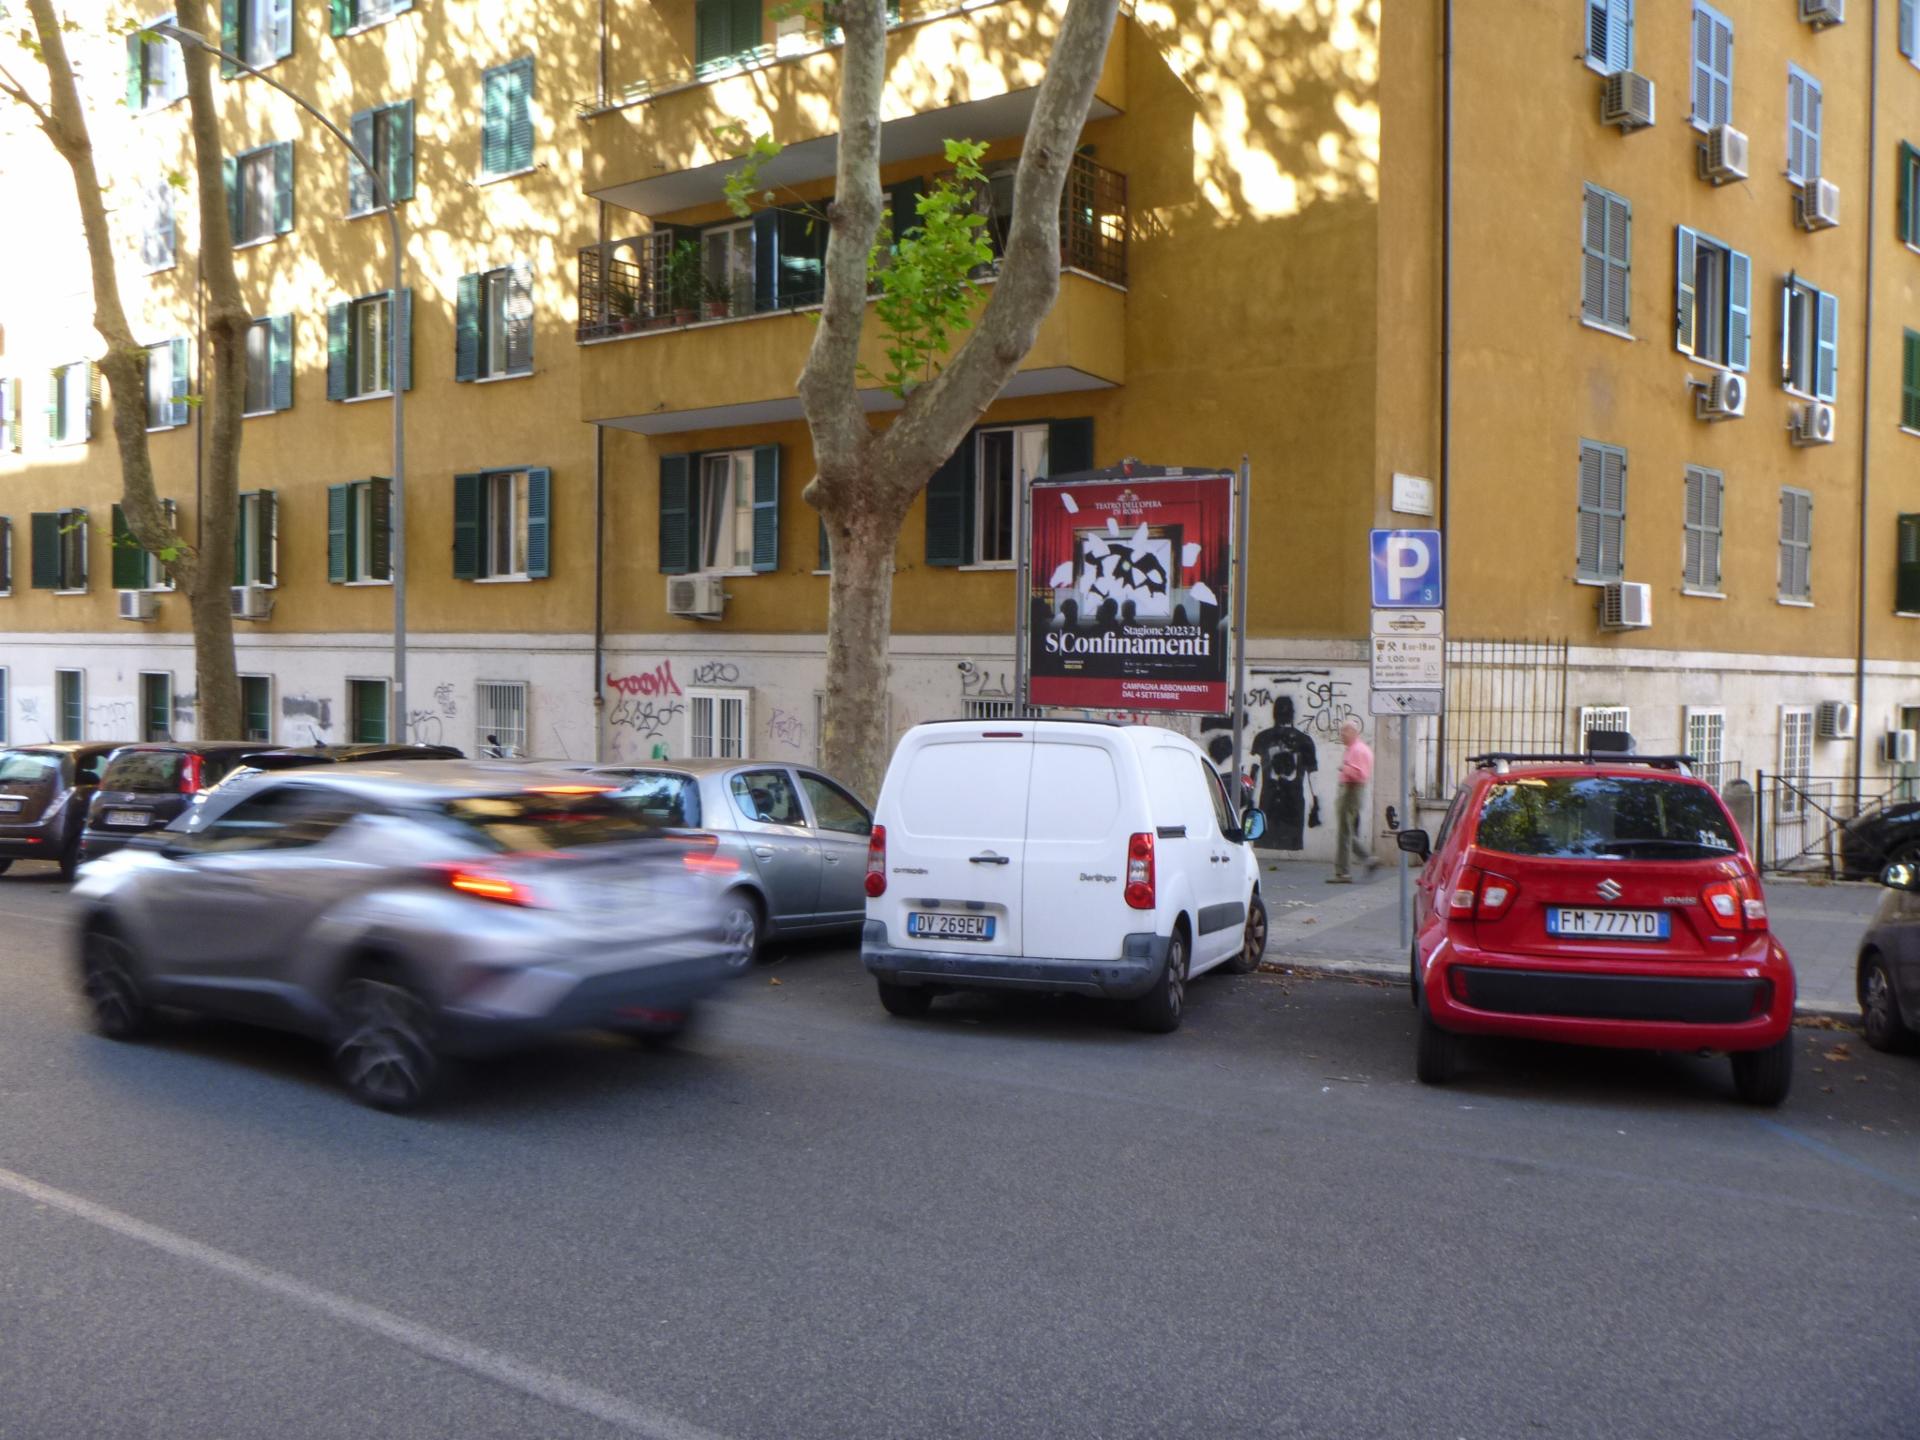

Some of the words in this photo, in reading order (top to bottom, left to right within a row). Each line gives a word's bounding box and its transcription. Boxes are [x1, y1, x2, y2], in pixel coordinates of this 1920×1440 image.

[1387, 537, 1430, 600] P
[1424, 589, 1433, 601] 3
[1123, 625, 1164, 637] Stagione
[1122, 682, 1159, 691] CAMPAGNA
[1160, 683, 1209, 693] ABBONAMENTI
[1122, 690, 1135, 698] DAL
[1140, 691, 1180, 700] SETTEMBRE
[917, 915, 935, 932] DV
[940, 917, 985, 934] 269EW
[1561, 911, 1585, 931] FM
[1594, 911, 1655, 934] 777YD
